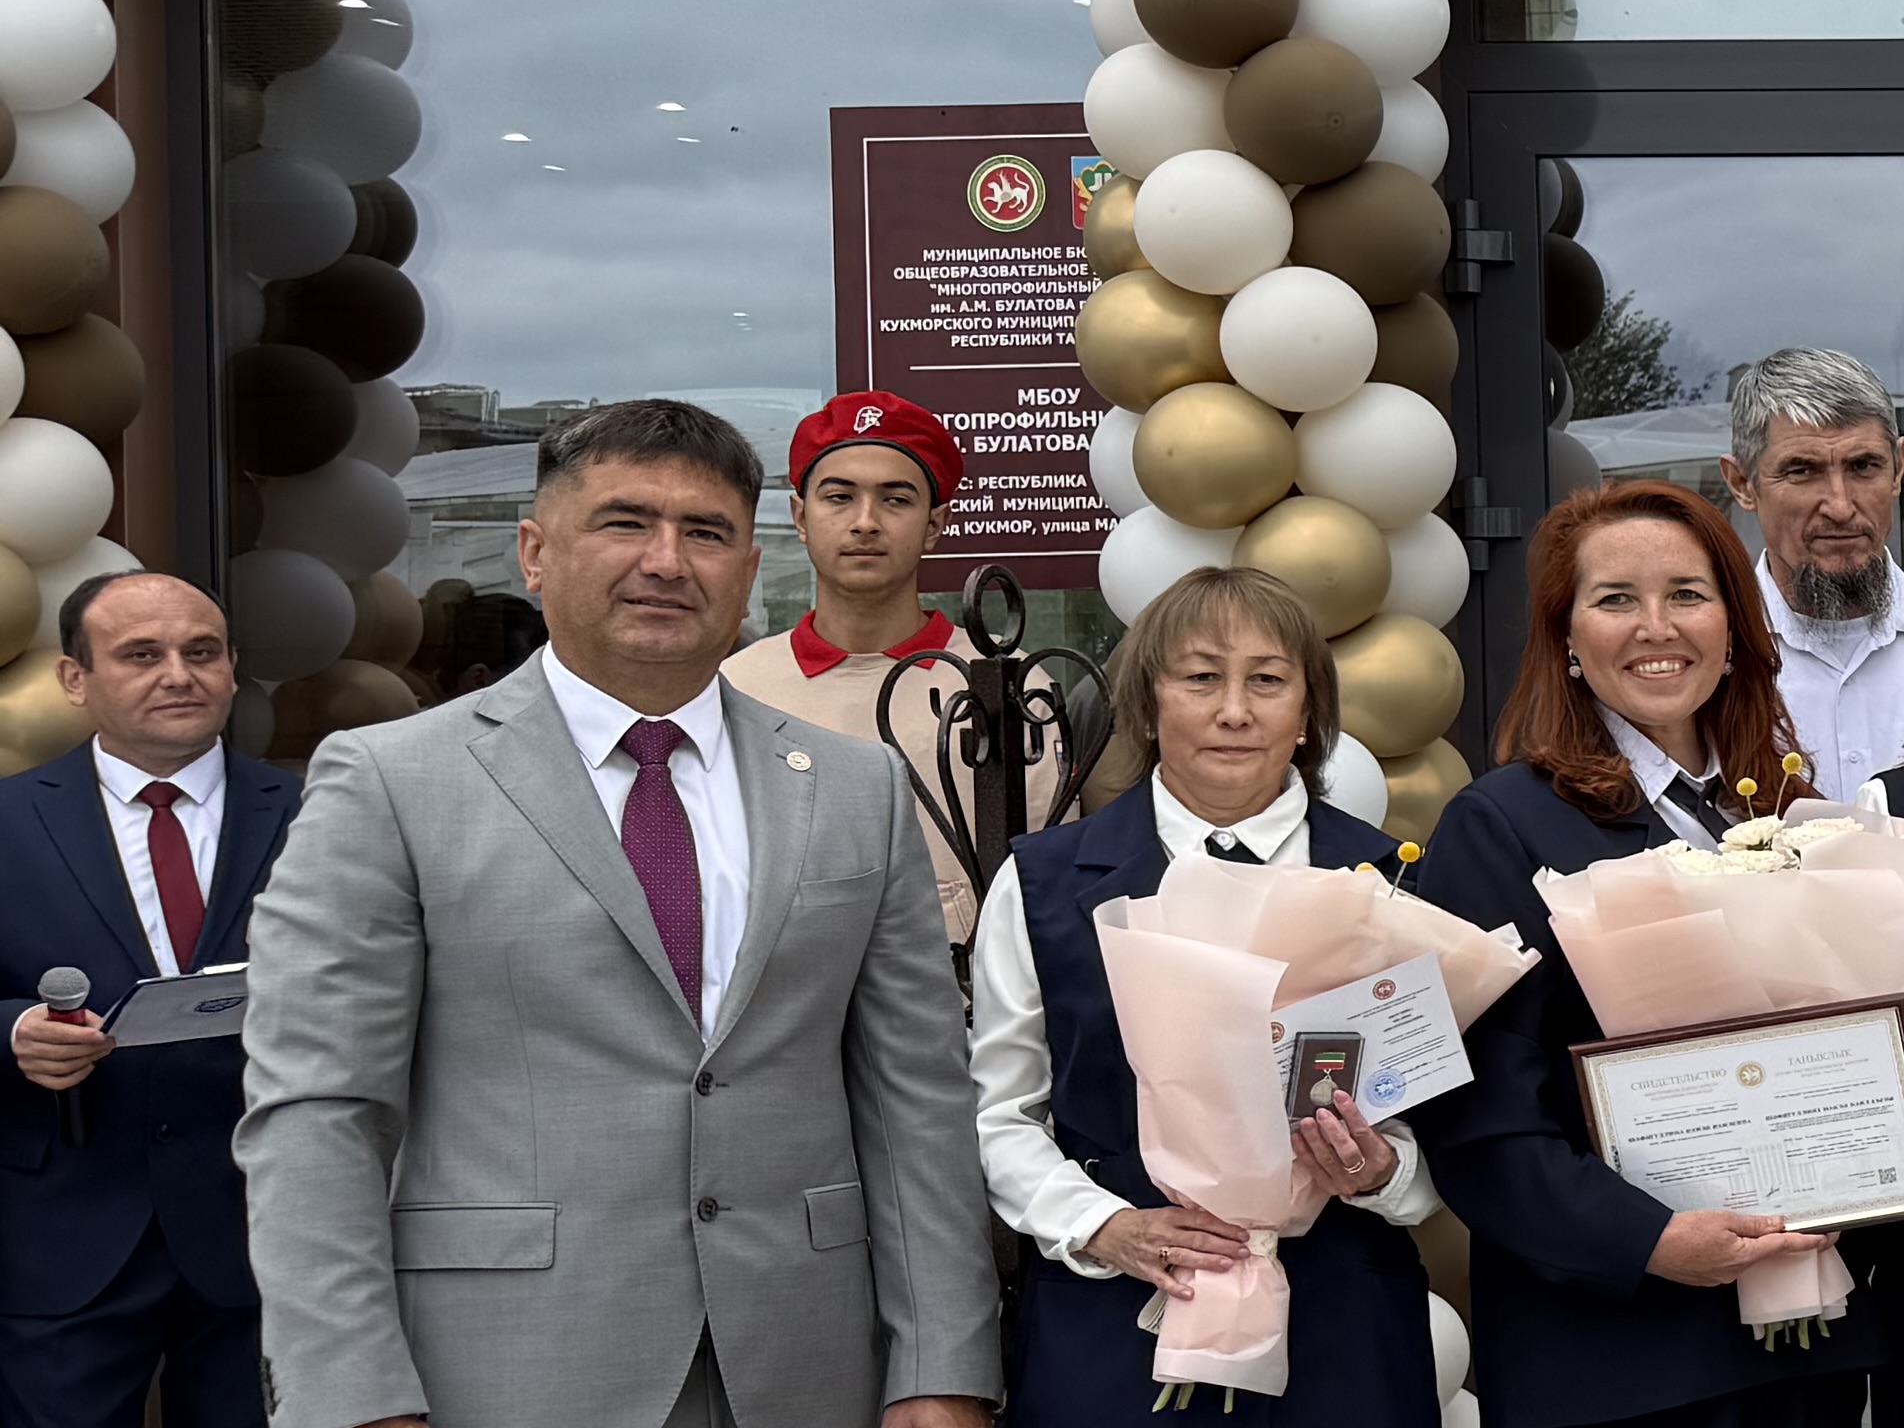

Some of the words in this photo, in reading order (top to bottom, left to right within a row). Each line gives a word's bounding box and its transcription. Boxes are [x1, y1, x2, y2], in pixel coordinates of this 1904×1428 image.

[922, 247, 1062, 263] МУНИЦИПАЛЬНОЕ
[893, 263, 1089, 281] ОБЩЕОБРАЗОВАТЕЛЬНОЕ
[930, 303, 956, 313] им.
[959, 300, 991, 313] А.М.
[995, 298, 1076, 312] БУЛАТОВА
[880, 318, 993, 332] КУКМОРСКОГО
[951, 334, 1053, 348] РЕСПУБЛИКИ
[1017, 388, 1081, 406] МБОУ
[974, 434, 1090, 453] БУЛАТОВА
[978, 474, 1087, 490] РЕСПУБЛИКА
[964, 520, 1037, 536] КУКМОР,
[1042, 520, 1091, 536] улица
